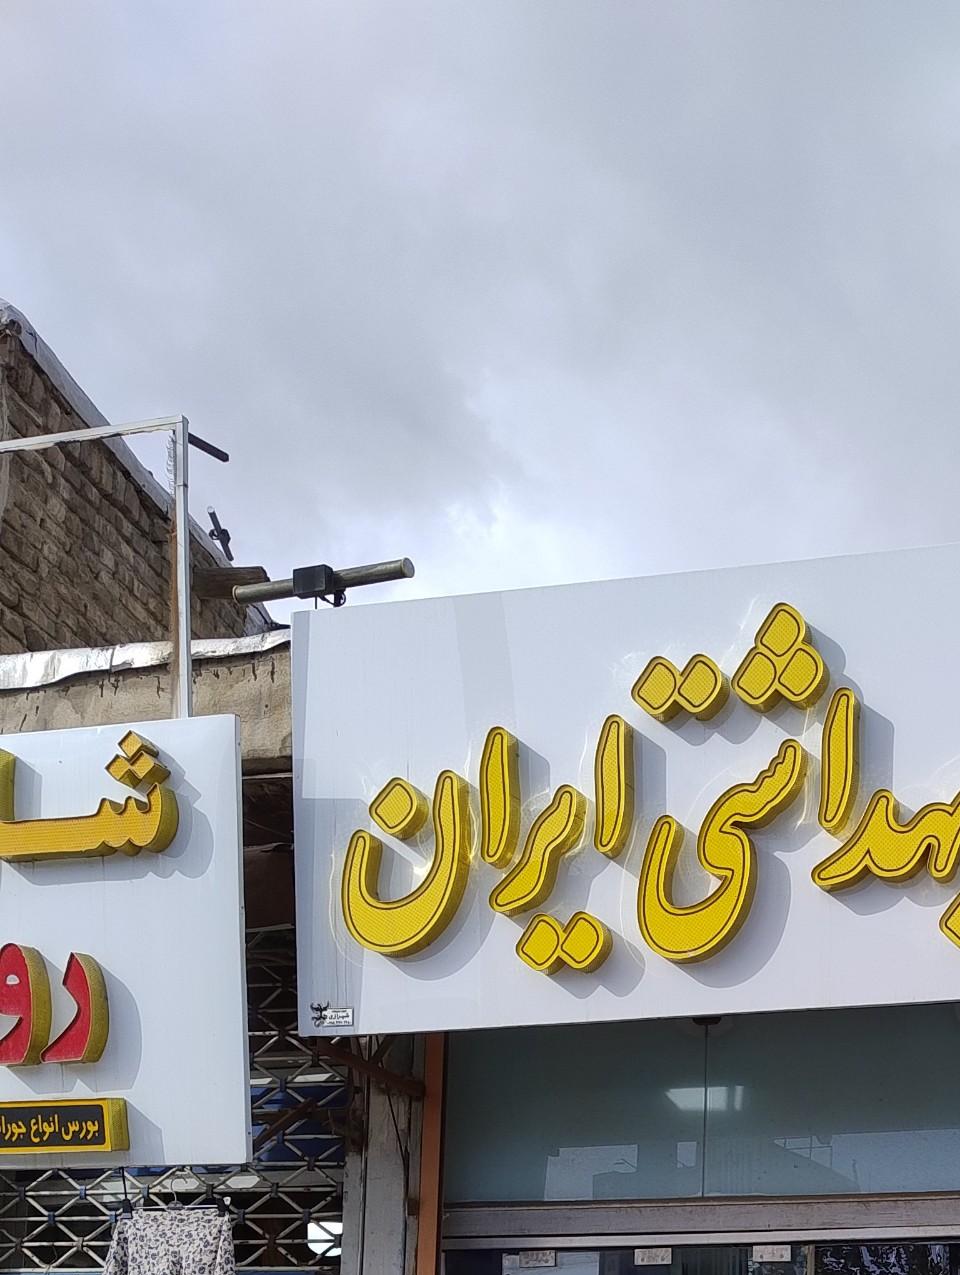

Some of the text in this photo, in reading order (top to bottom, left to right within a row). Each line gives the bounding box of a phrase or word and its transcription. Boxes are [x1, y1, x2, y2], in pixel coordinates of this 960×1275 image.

[342, 714, 634, 974] ایران
[0, 1113, 99, 1143] بورس انواع جورا
